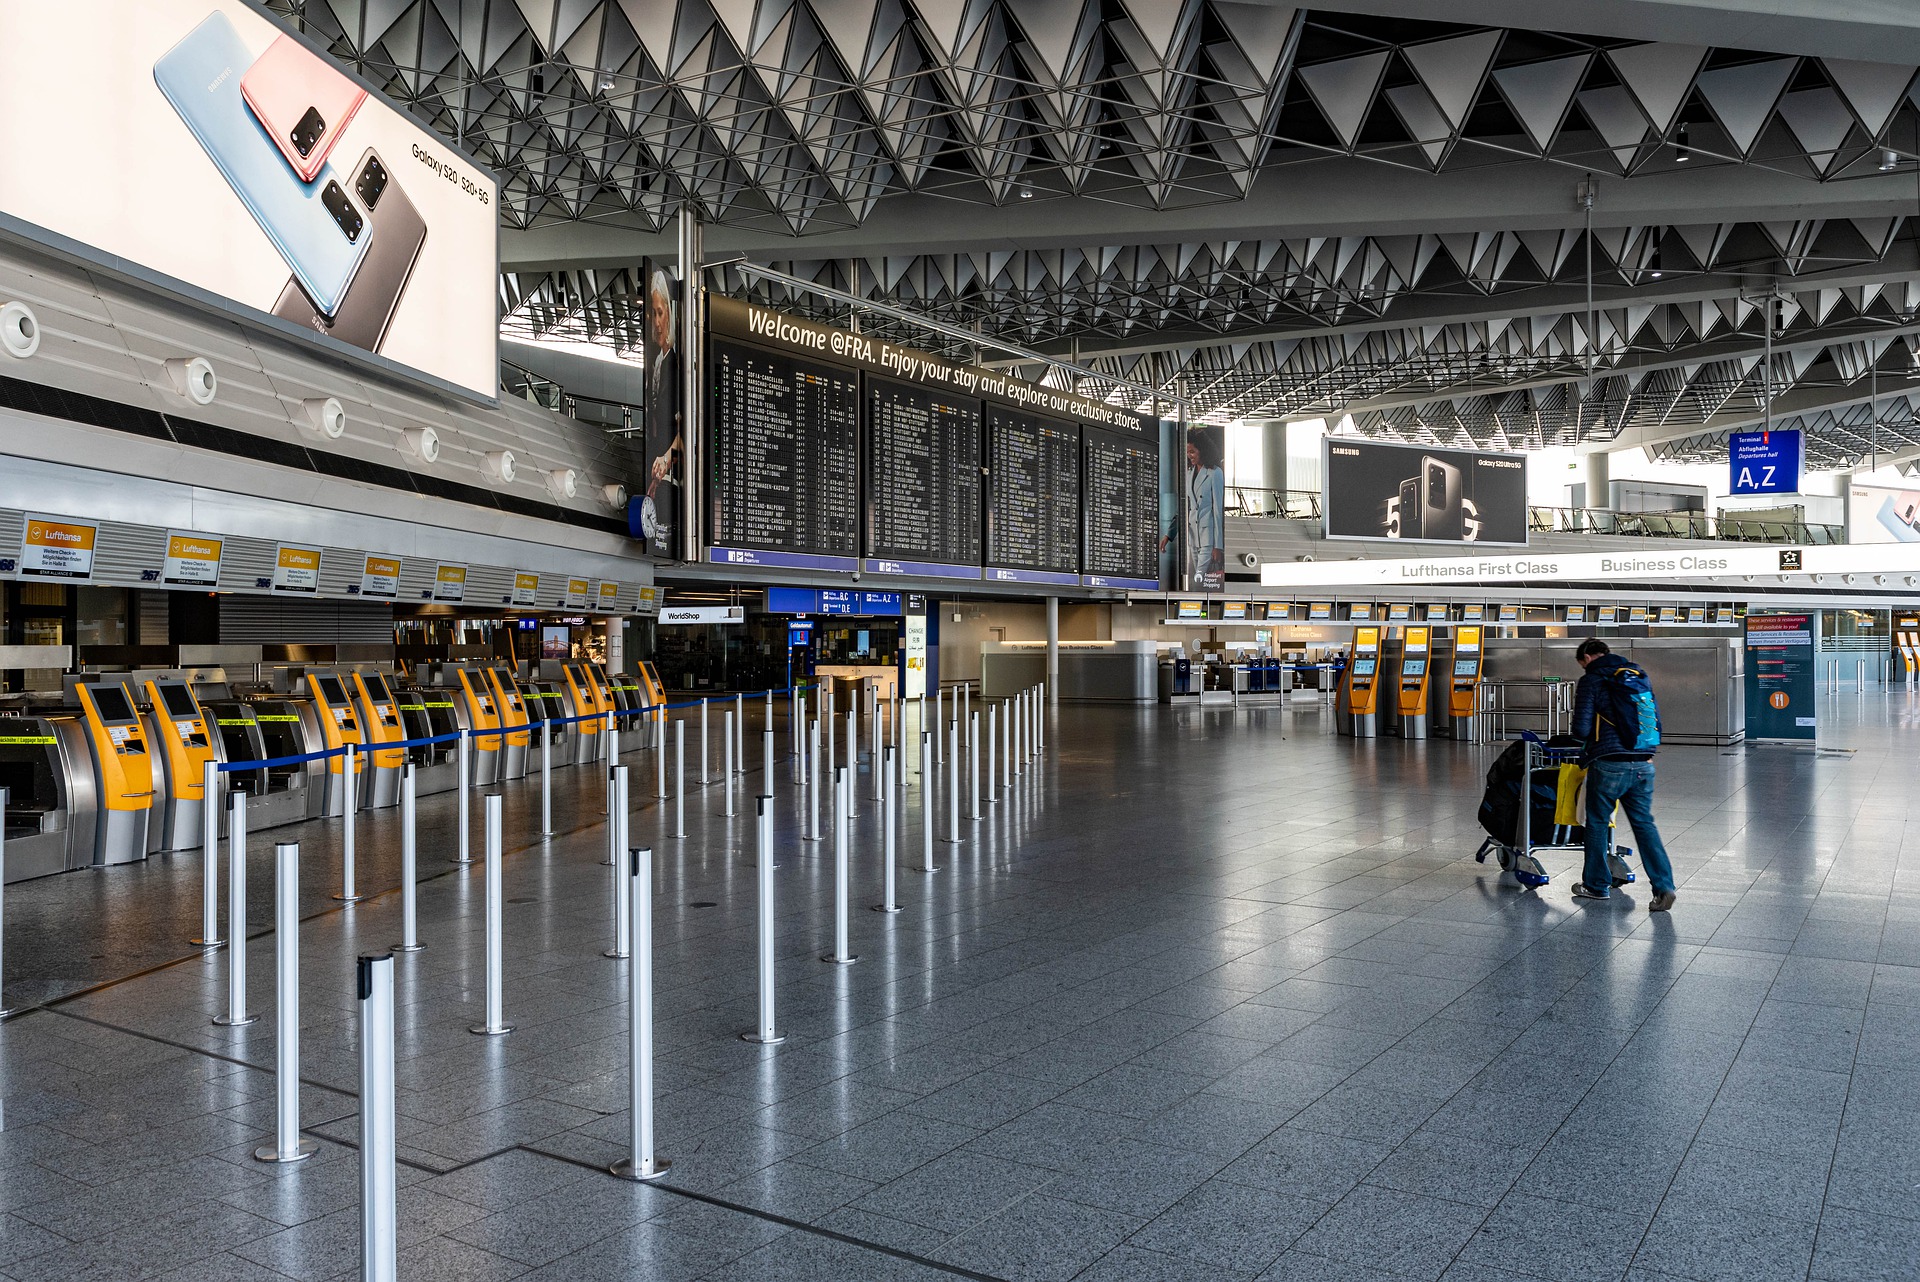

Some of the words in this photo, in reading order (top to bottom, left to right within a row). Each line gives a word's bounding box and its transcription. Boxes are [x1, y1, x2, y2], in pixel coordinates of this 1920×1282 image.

[412, 144, 443, 177] Galaxy
[444, 165, 457, 184] S20
[479, 188, 488, 204] 5G
[749, 308, 826, 349] Welcome
[831, 332, 875, 363] @FRA.
[881, 345, 918, 379] Enjoy
[922, 360, 951, 381] your
[953, 367, 978, 394] stay
[981, 377, 1005, 396] and
[1008, 383, 1048, 406] explore
[1050, 395, 1069, 411] our
[1070, 400, 1112, 424] exclusive
[1114, 411, 1141, 431] stores.
[1478, 460, 1495, 468] Galaxy
[1737, 466, 1775, 489] A,Z
[1386, 496, 1478, 541] 5G
[45, 530, 81, 542] Lufthansa
[183, 545, 210, 554] Lufthansa
[290, 555, 312, 564] Lufthansa
[1601, 559, 1675, 572] Business
[1680, 557, 1727, 569] Class
[141, 570, 160, 580] 267
[1402, 564, 1474, 576] Lufthansa
[1479, 563, 1511, 575] First
[1515, 562, 1557, 574] Class
